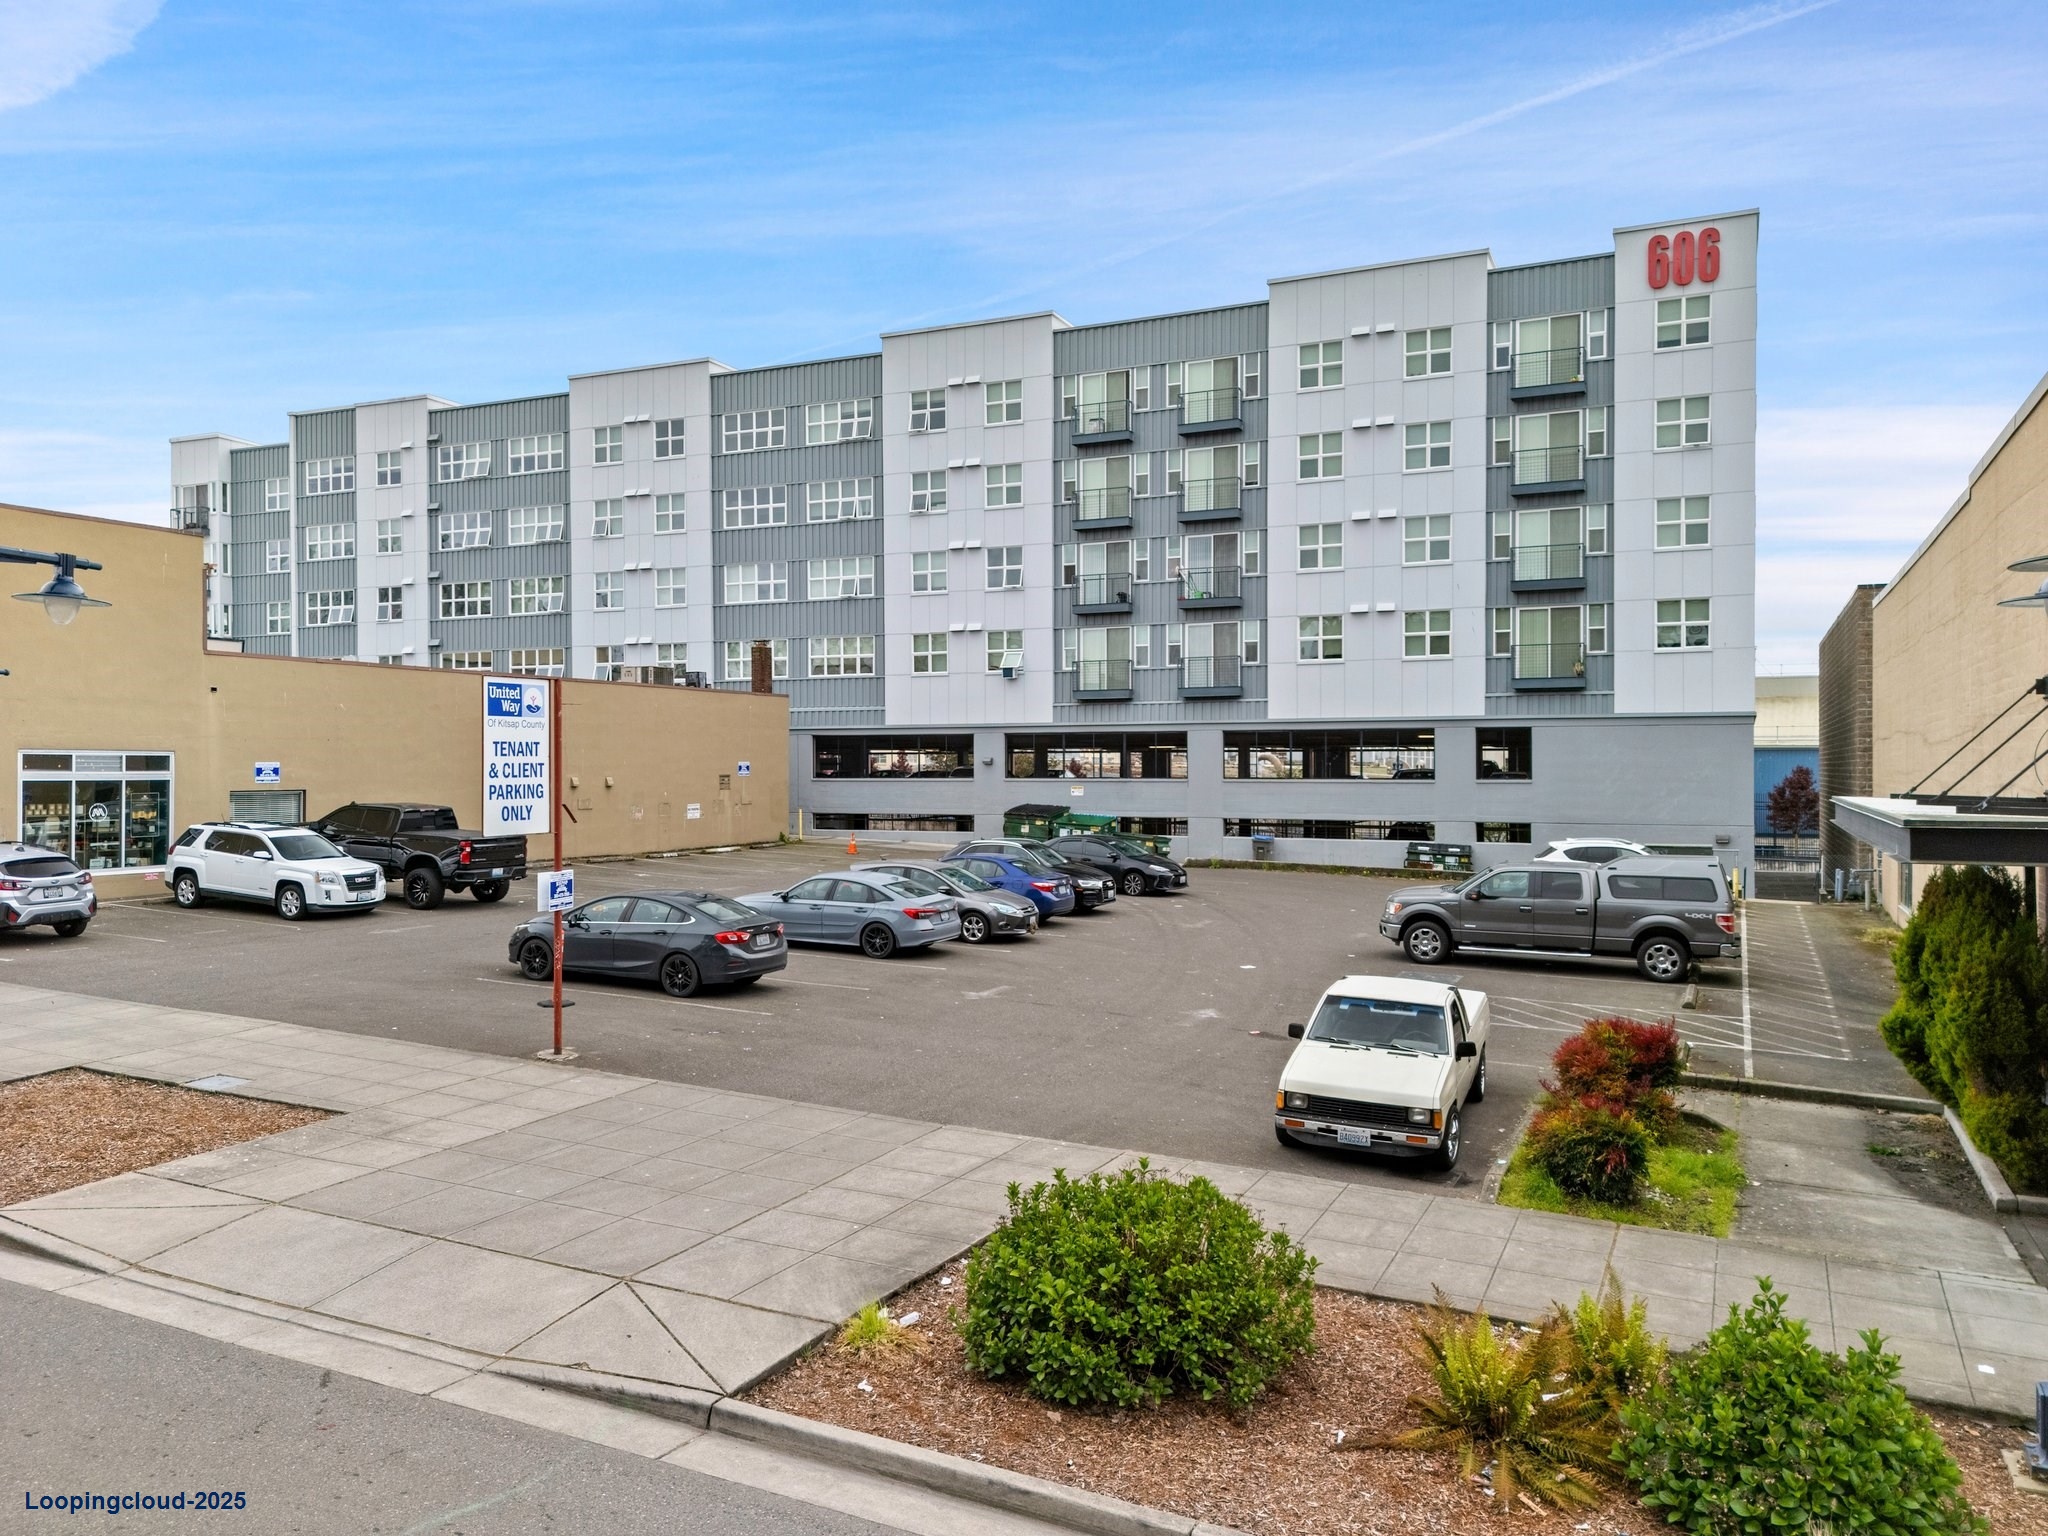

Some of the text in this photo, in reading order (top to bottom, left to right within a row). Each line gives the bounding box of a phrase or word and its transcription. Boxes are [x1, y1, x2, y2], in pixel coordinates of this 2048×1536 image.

[1648, 227, 1720, 290] 606
[488, 685, 521, 699] United
[501, 699, 520, 716] Way
[487, 718, 546, 731] Of Kitsap County
[492, 741, 540, 757] TENANT
[488, 762, 545, 779] & CLIENT
[488, 783, 544, 801] PARKING
[501, 804, 533, 822] ONLY
